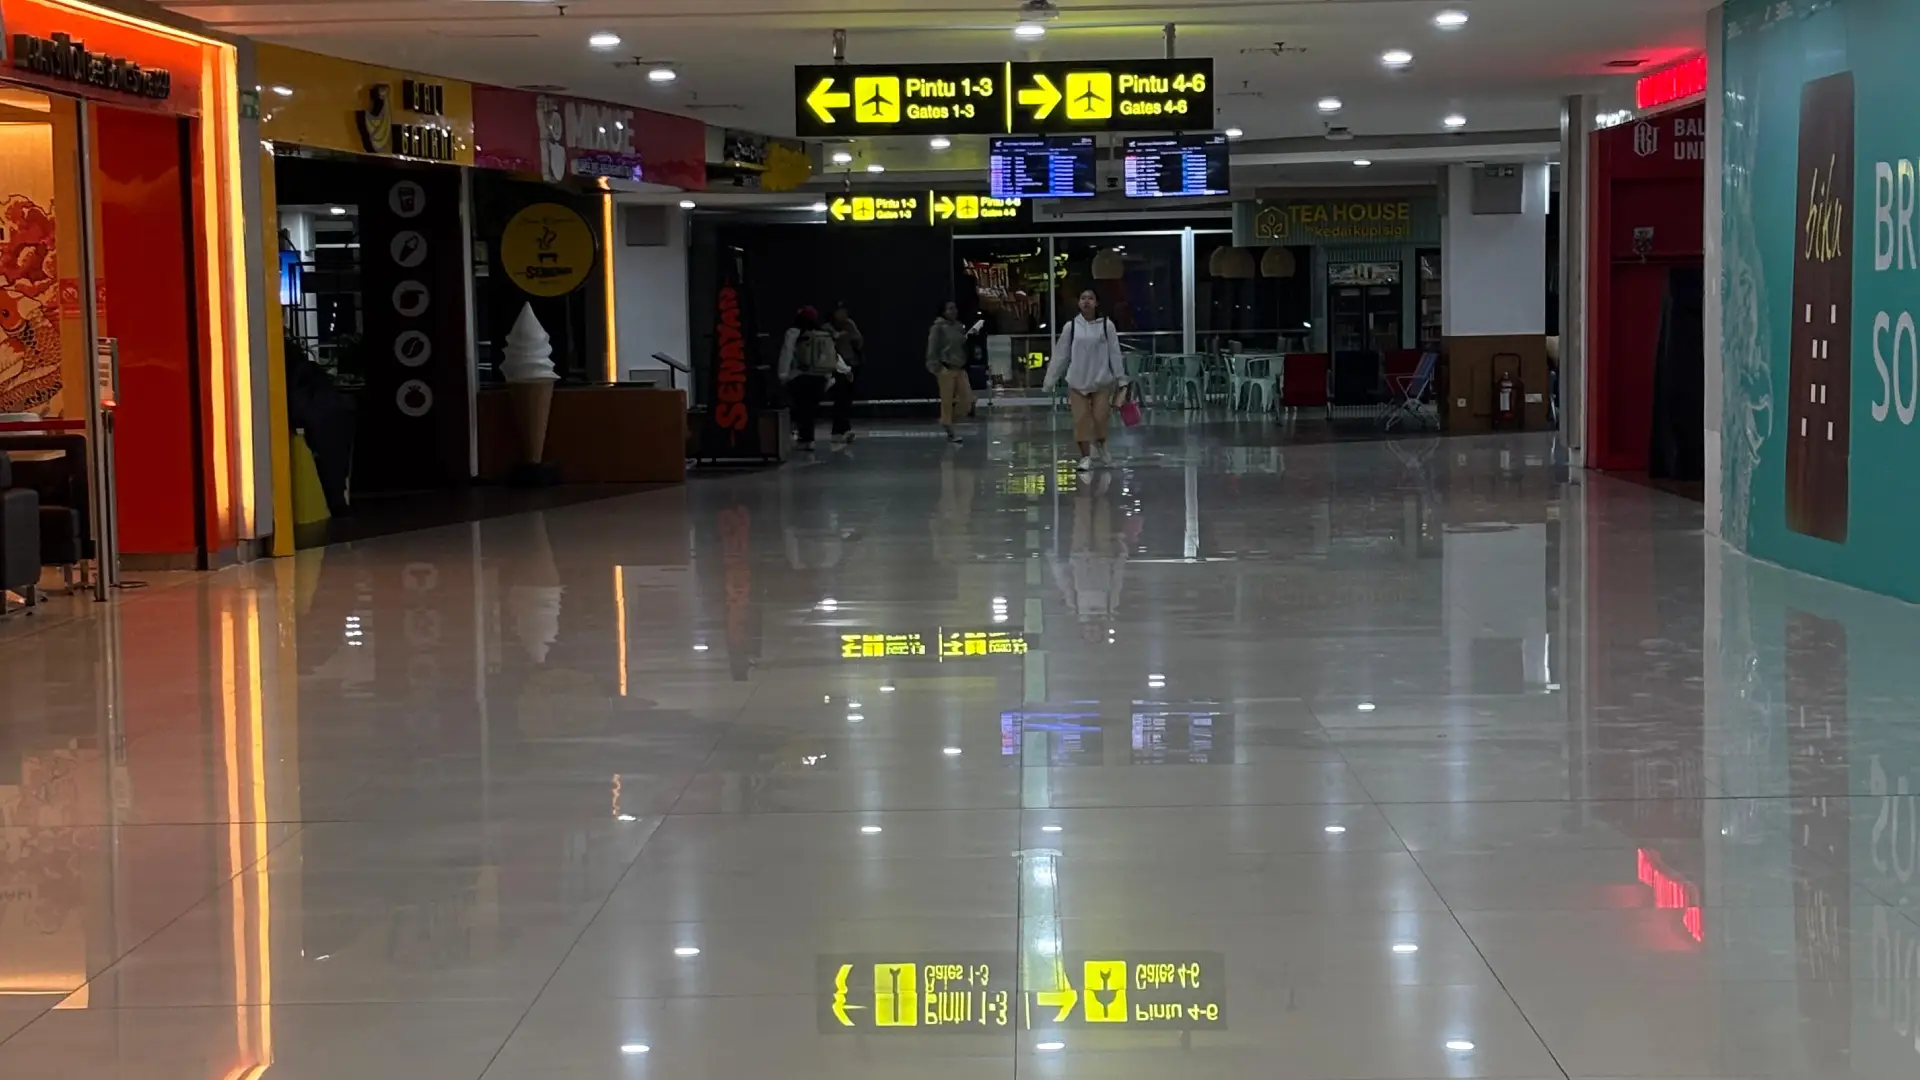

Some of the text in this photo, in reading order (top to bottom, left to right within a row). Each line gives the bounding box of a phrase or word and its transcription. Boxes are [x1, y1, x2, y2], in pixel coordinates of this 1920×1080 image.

[906, 77, 993, 97] Pintu 1-3
[1118, 73, 1206, 94] Pintu 4-6
[906, 103, 975, 119] Gates 1-3
[1119, 99, 1188, 115] Gates 4-6
[1288, 202, 1410, 223] TEA HOUSE
[1875, 158, 1920, 271] BR
[716, 286, 748, 430] SENAYAN
[1872, 311, 1918, 425] SO
